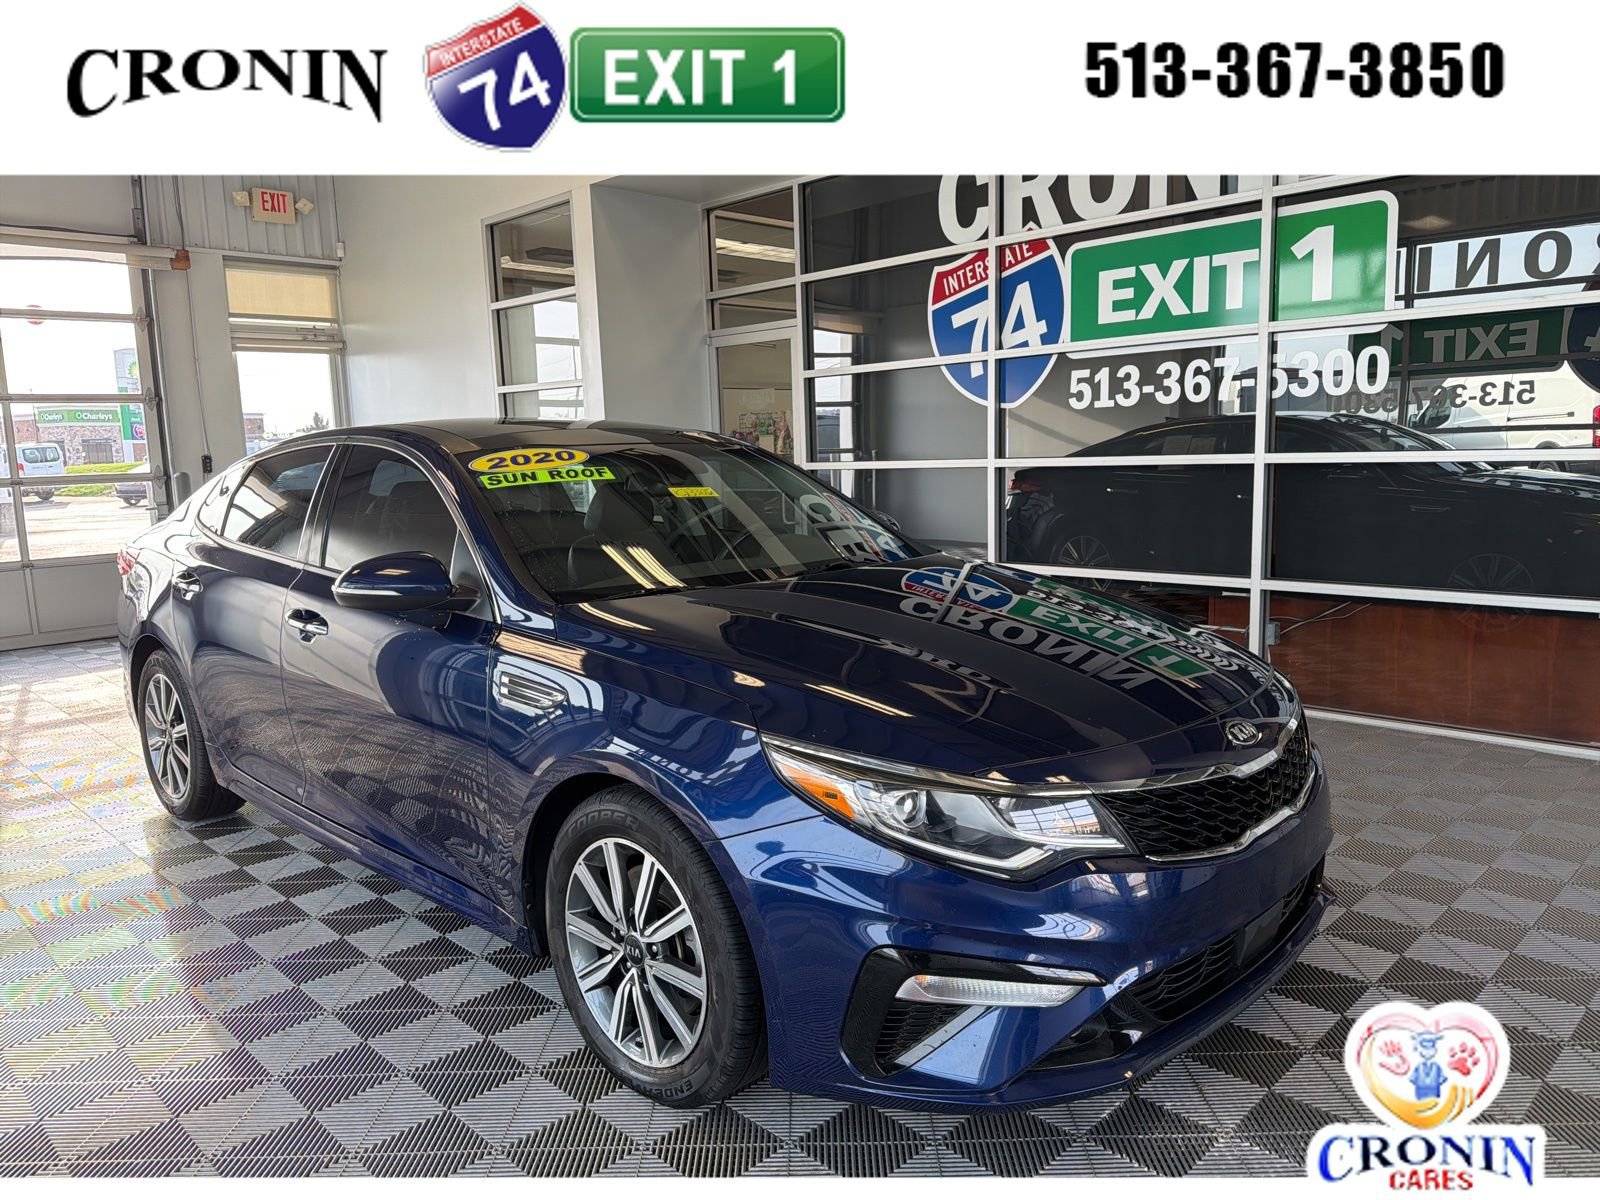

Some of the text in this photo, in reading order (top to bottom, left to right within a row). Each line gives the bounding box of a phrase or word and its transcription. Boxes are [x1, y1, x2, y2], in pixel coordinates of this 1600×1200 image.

[261, 191, 288, 214] EXIT
[943, 241, 1033, 296] INTERSATE
[1098, 225, 1335, 324] EXIT 1
[951, 281, 1048, 379] 74
[1068, 345, 1390, 411] 513-367-5300
[486, 450, 576, 470] 2020
[487, 467, 608, 486] SUN ROOF
[626, 944, 641, 959] KIA
